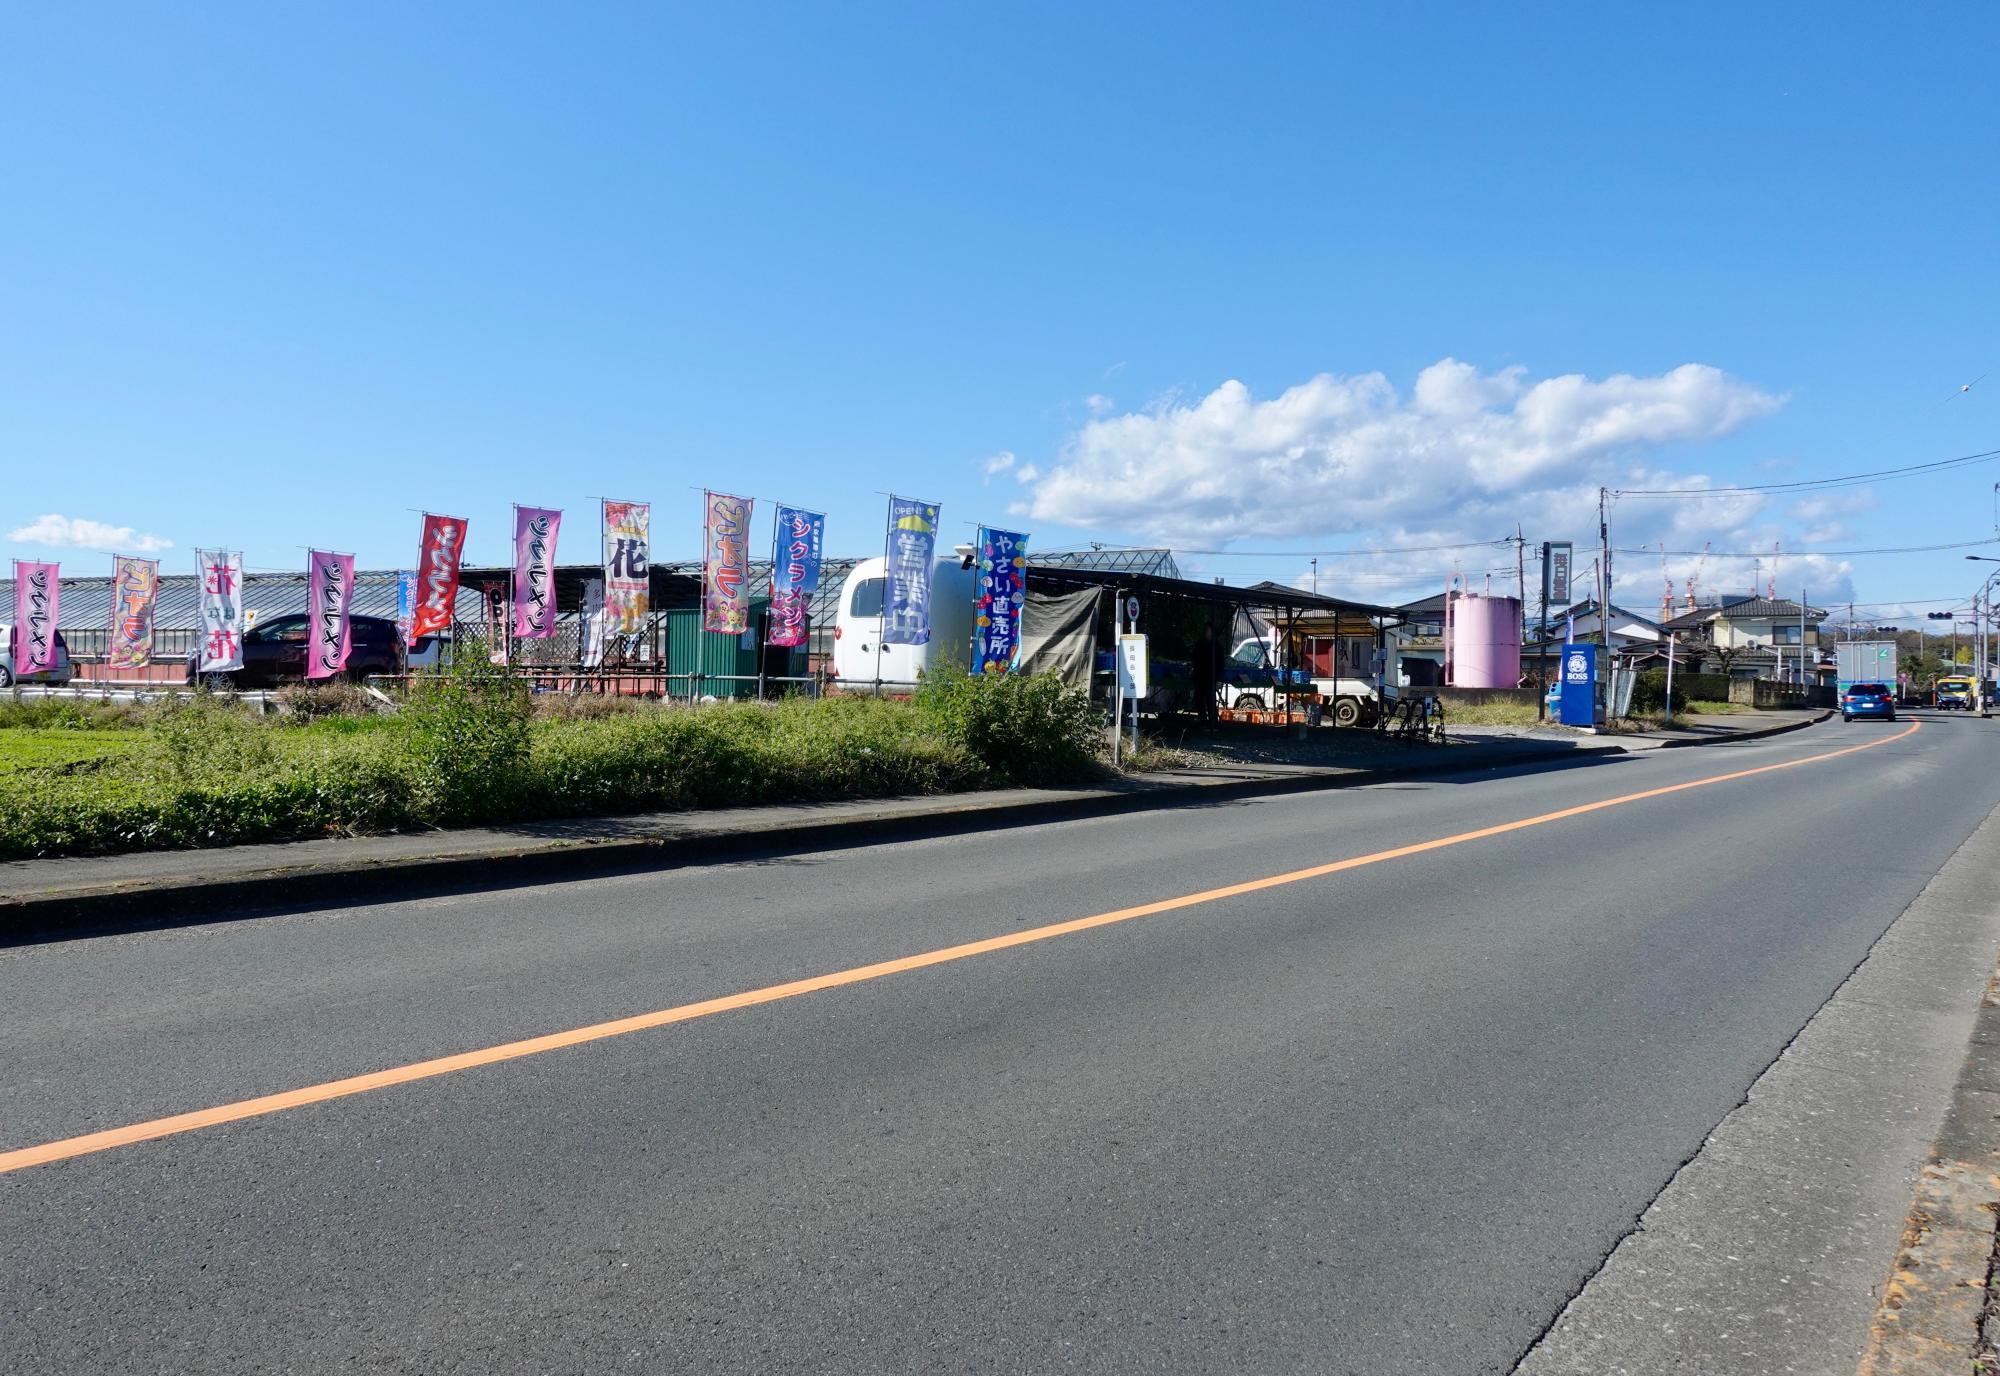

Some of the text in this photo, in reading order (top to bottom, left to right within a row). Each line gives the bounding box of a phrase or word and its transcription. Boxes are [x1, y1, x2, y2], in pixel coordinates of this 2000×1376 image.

[607, 538, 648, 579] 花
[784, 518, 811, 626] シクラメン
[893, 533, 928, 639] 営業中
[989, 535, 1013, 655] やさい直売所
[1567, 672, 1588, 681] BOSS
